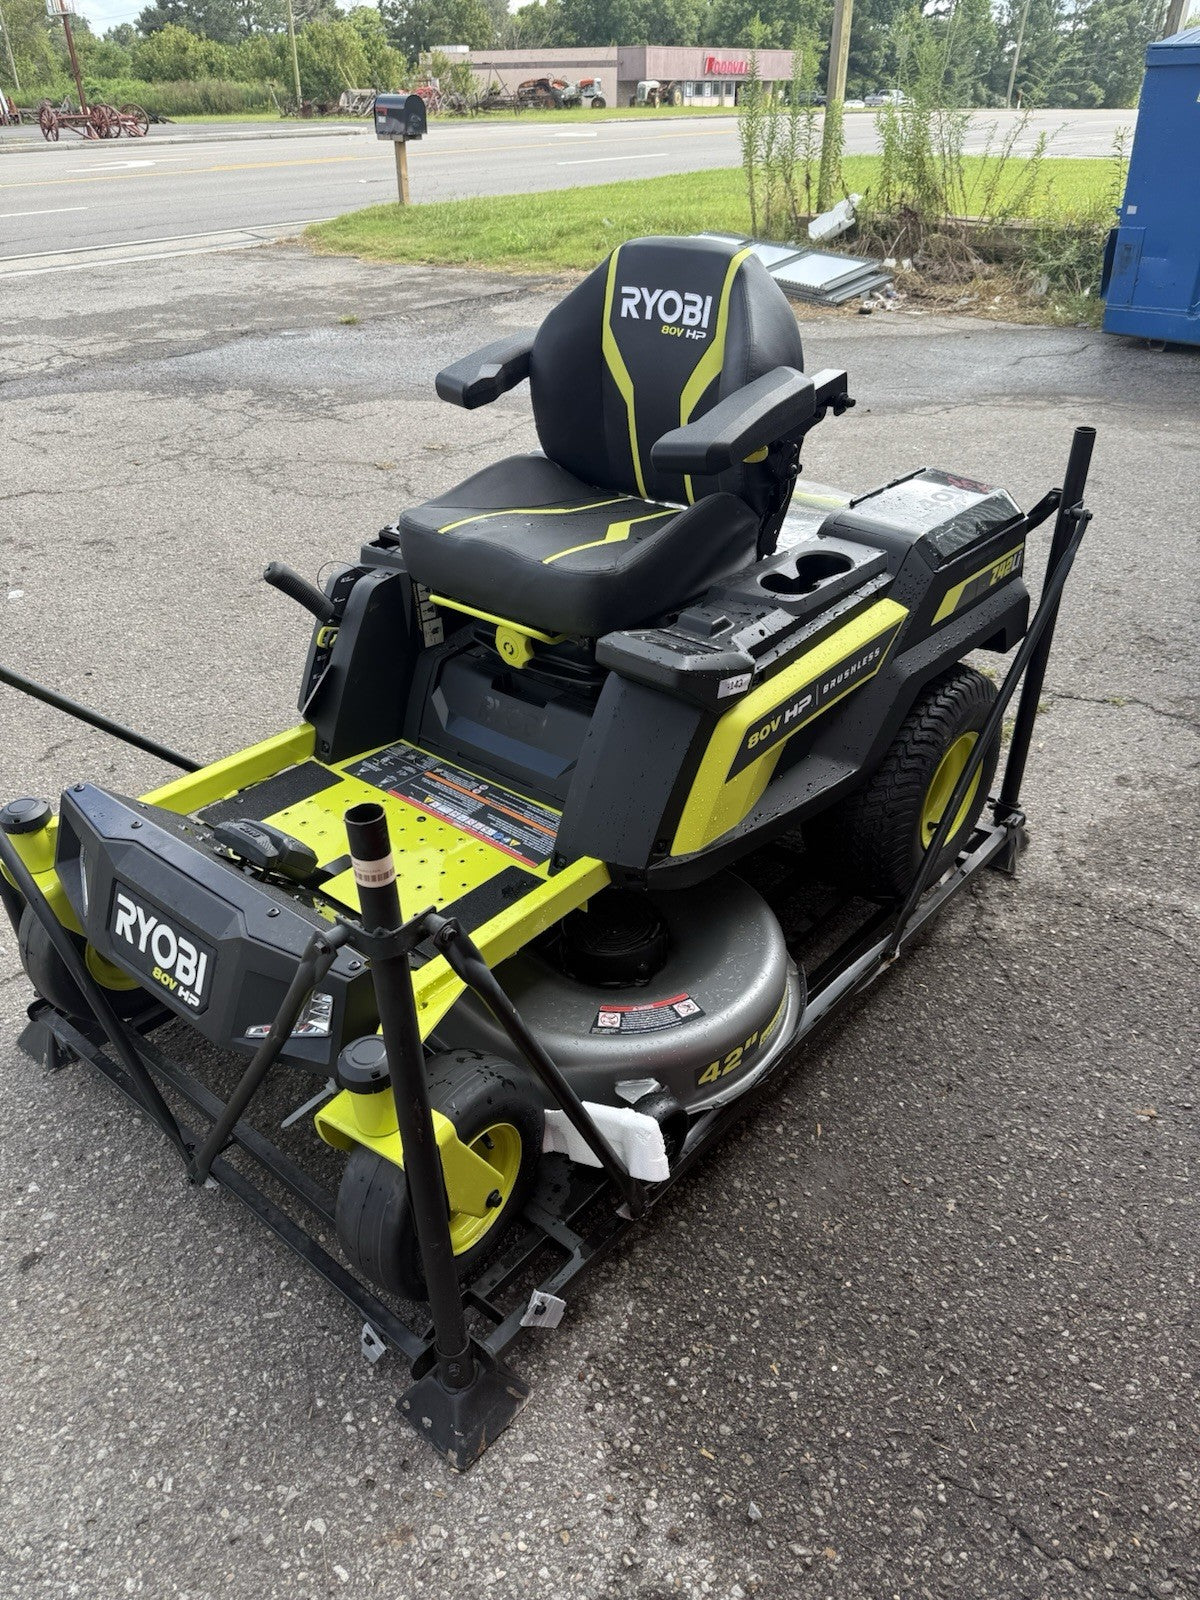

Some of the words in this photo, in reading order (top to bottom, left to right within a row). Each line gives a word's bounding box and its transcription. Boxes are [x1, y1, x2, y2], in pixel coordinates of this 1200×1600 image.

[621, 286, 713, 329] RYOBI
[661, 325, 685, 338] 80V
[685, 329, 707, 340] HP
[747, 714, 782, 749] 80V
[783, 694, 813, 724] HP
[822, 647, 881, 695] BRUSHLESS
[115, 893, 208, 996] RYOBI
[152, 967, 178, 991] 80V
[177, 986, 201, 1007] HP
[698, 1031, 759, 1085] 42"
